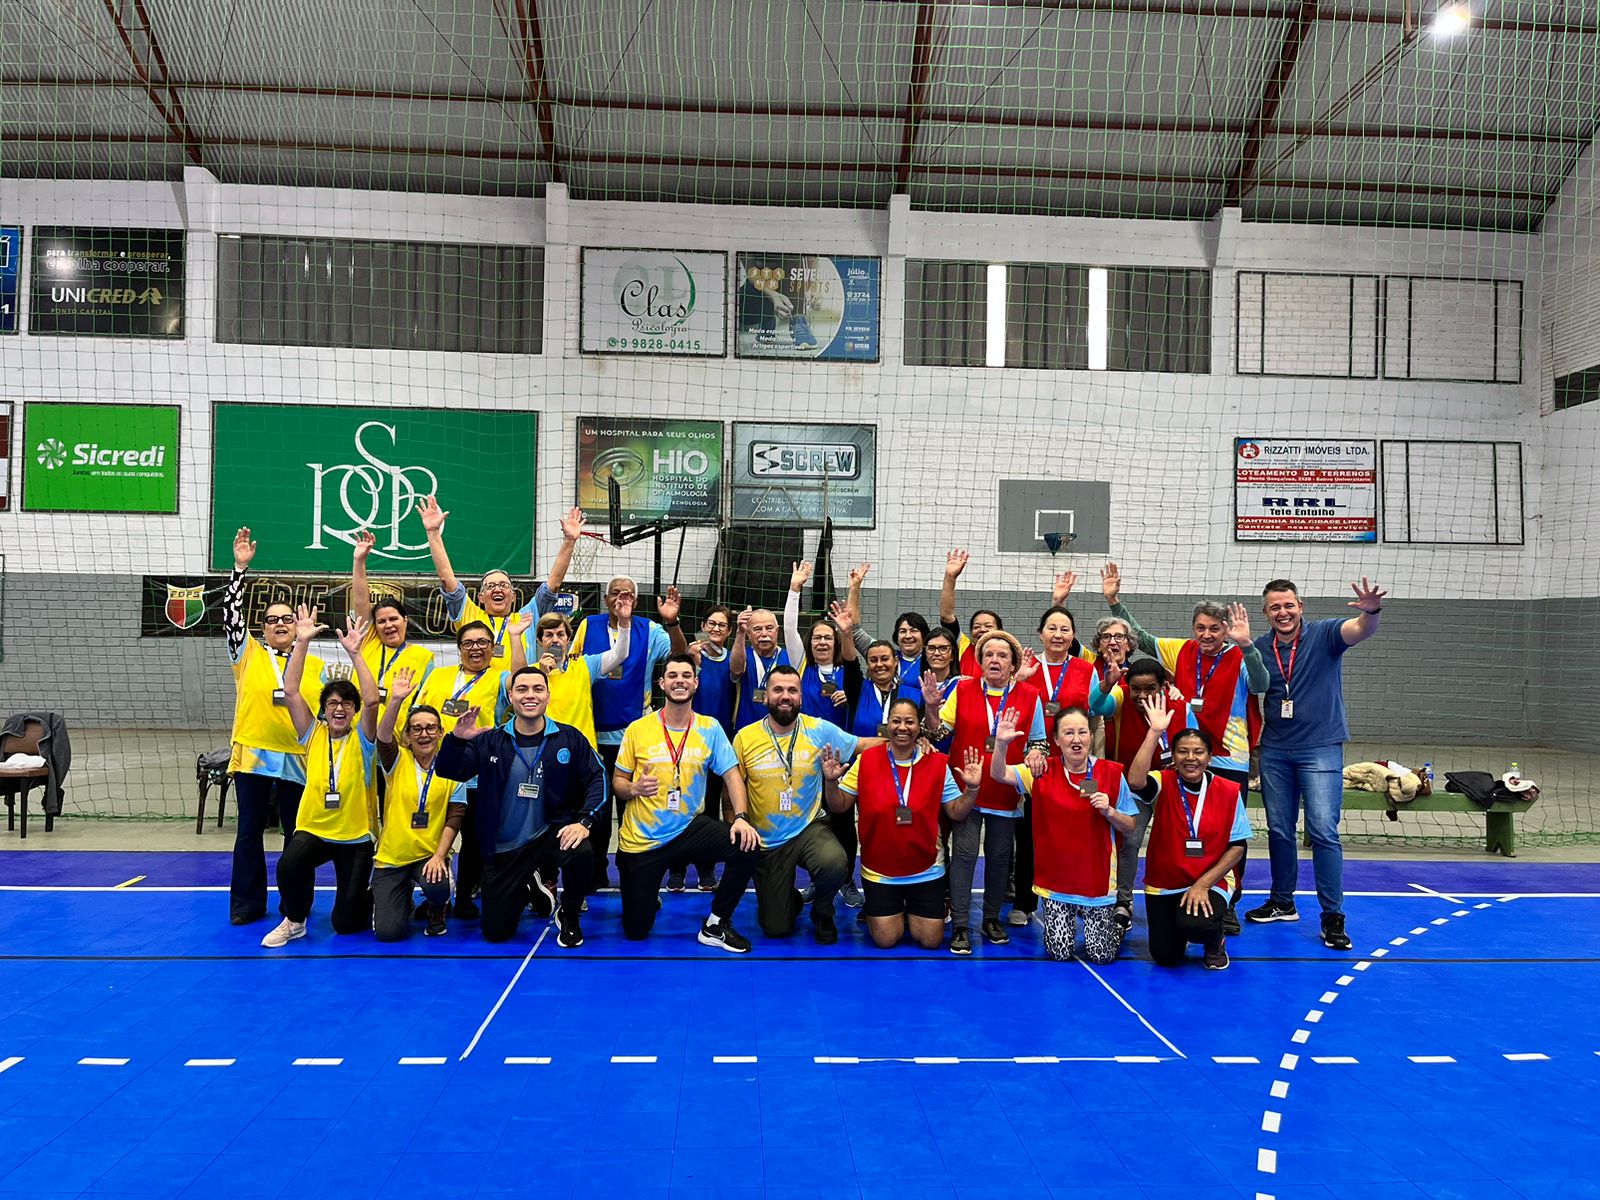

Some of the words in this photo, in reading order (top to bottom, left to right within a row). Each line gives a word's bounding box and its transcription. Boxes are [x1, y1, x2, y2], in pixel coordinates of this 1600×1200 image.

[67, 250, 118, 258] transformar
[128, 251, 171, 260] prosperar,
[103, 259, 170, 273] cooperar.
[51, 287, 136, 304] UNICRED
[620, 280, 695, 318] Clas
[631, 318, 687, 337] Psicologia
[632, 338, 700, 350] 9828-0415
[641, 430, 664, 438] PARA
[666, 431, 686, 439] SEUS
[687, 432, 716, 440] OLHOS
[72, 443, 165, 467] Sicredi
[1264, 446, 1301, 455] RIZZATTI
[1305, 443, 1341, 456] IMÓVEIS
[1345, 446, 1370, 456] LTDA.
[653, 449, 709, 475] HIO
[780, 450, 854, 472] SCREW
[1236, 469, 1298, 477] LOTEAMENTO
[1321, 470, 1371, 478] TERRENOS
[653, 482, 695, 490] INSTITUTO
[668, 499, 708, 507] ECNOLOGIA
[751, 497, 805, 506] CONTRIBUNDO
[1295, 509, 1335, 517] Entulho
[554, 597, 572, 607] BFS
